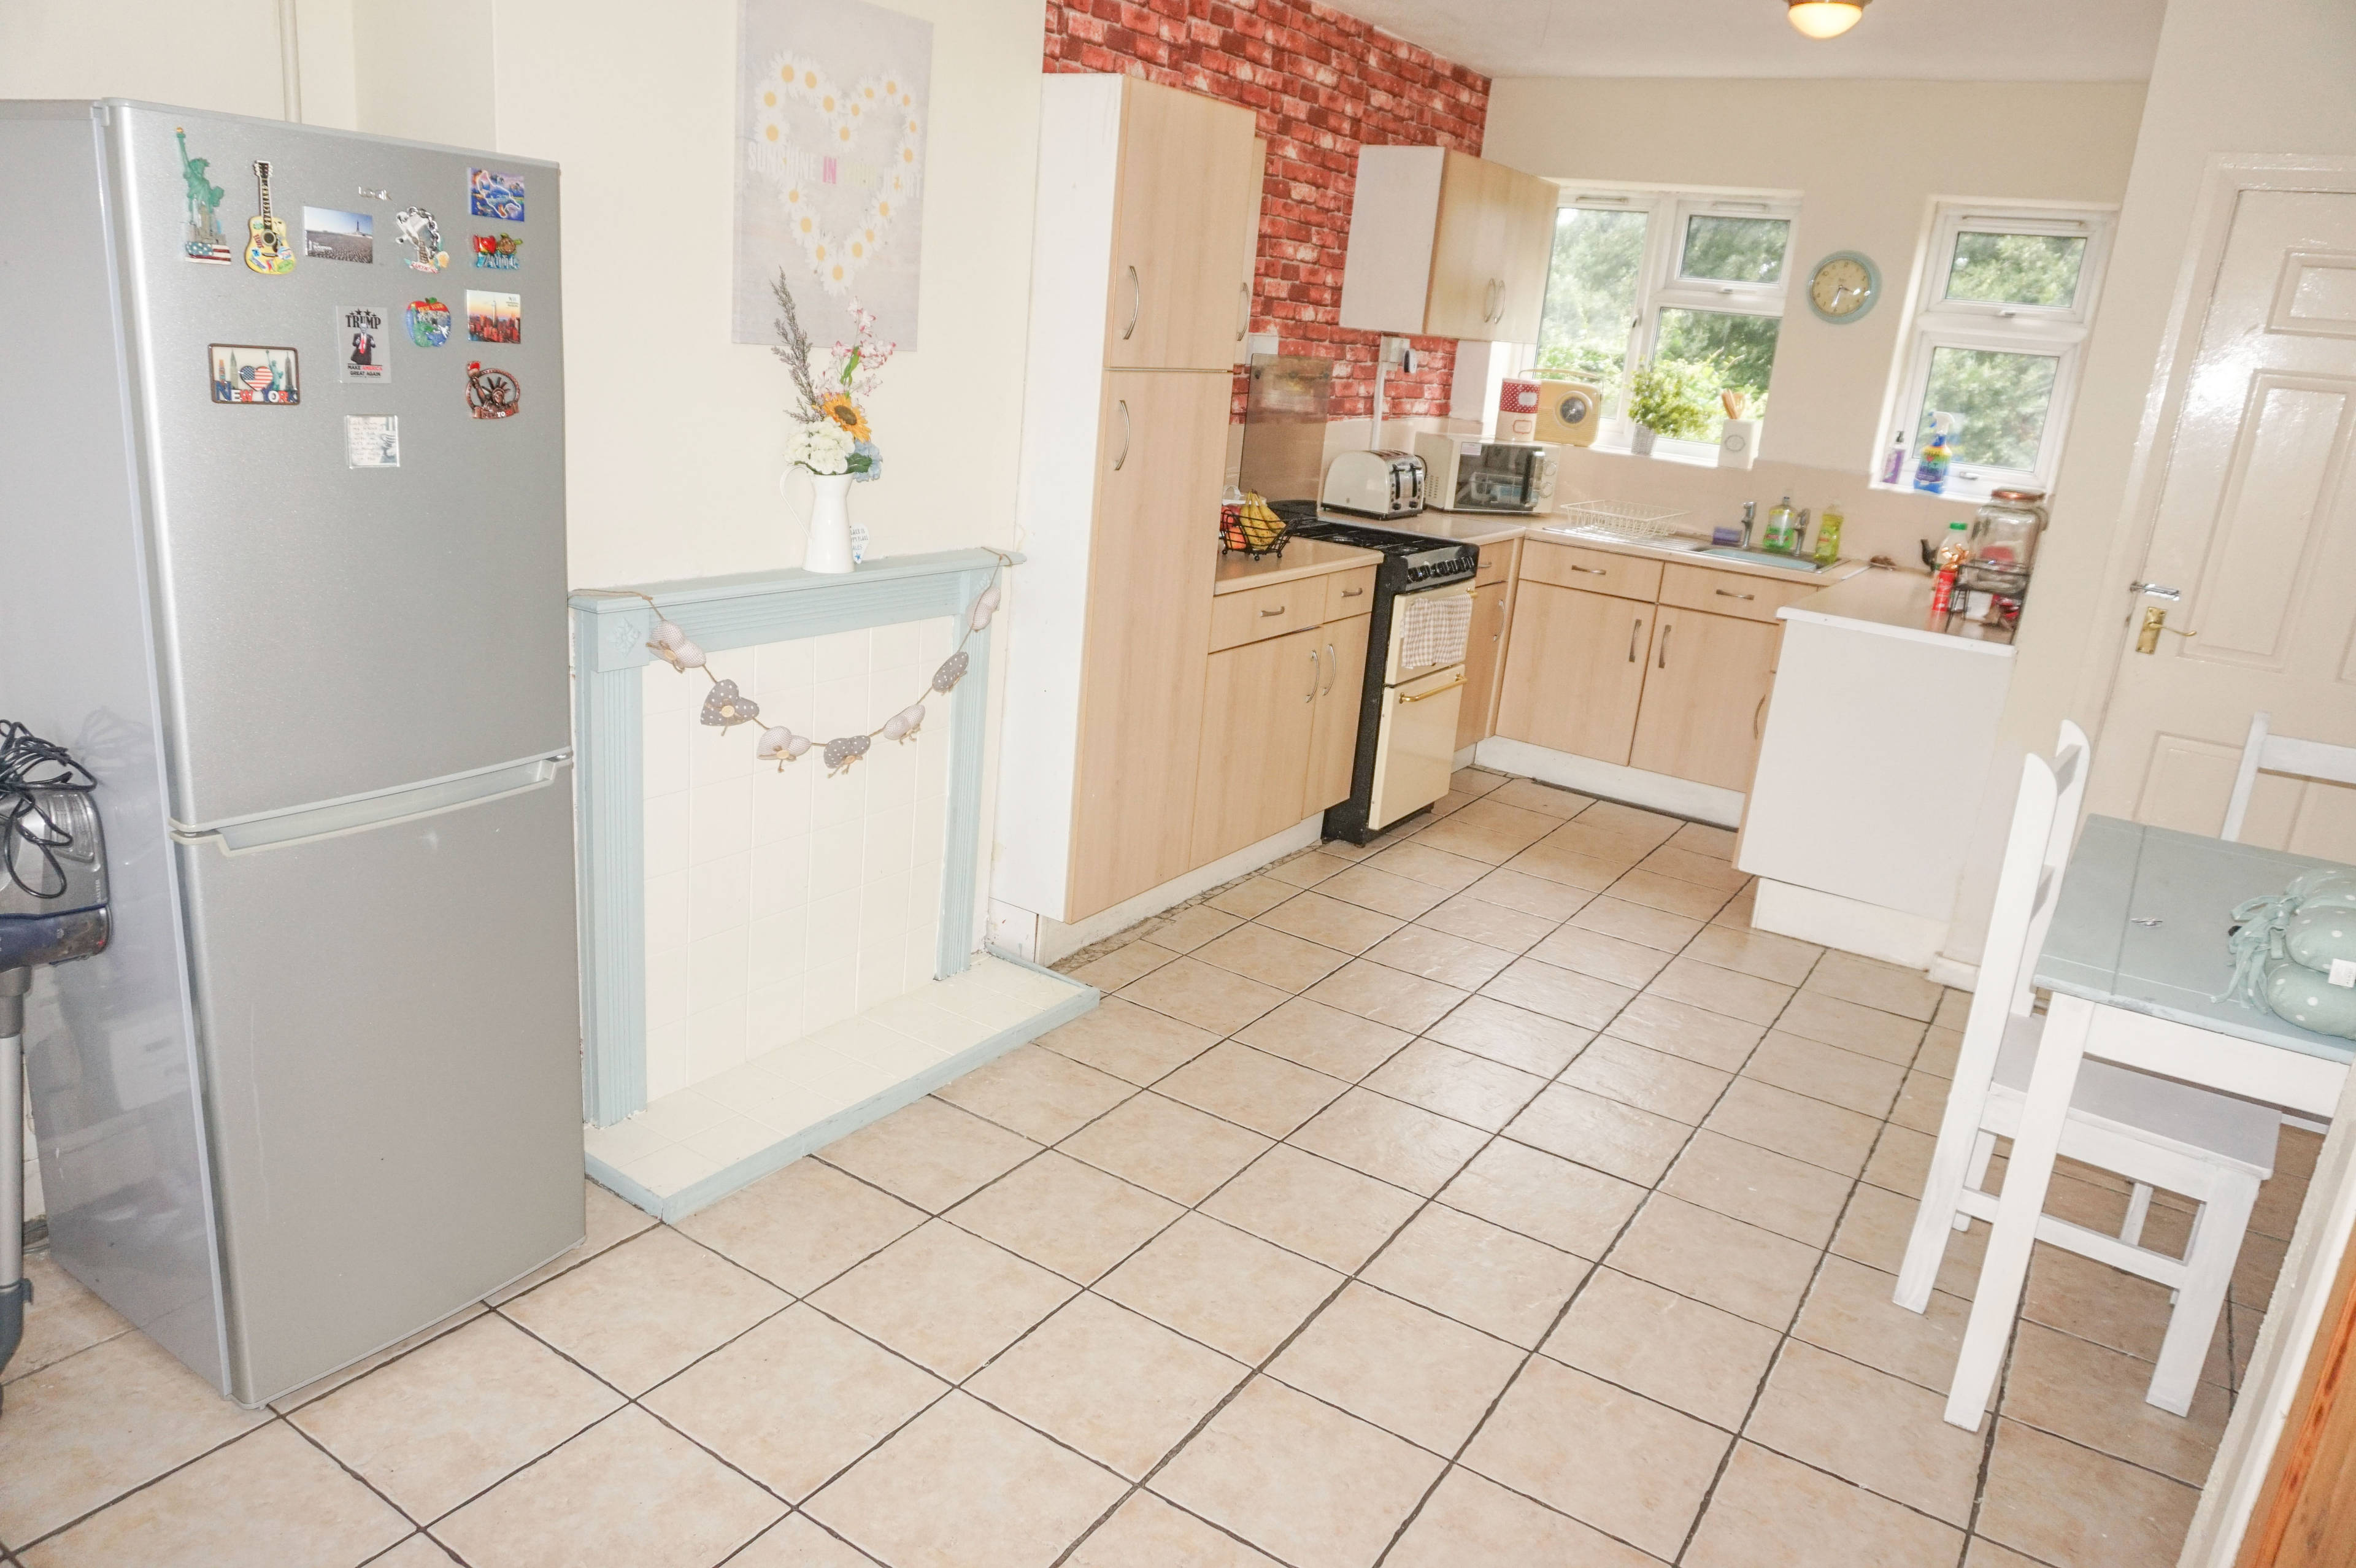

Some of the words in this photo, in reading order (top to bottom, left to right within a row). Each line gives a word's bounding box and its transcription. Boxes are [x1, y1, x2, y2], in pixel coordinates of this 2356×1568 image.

[748, 142, 815, 182] SUNSHINE
[822, 155, 837, 185] IN
[345, 315, 382, 329] TRUMP
[215, 380, 253, 403] NEW
[261, 383, 298, 404] YORK
